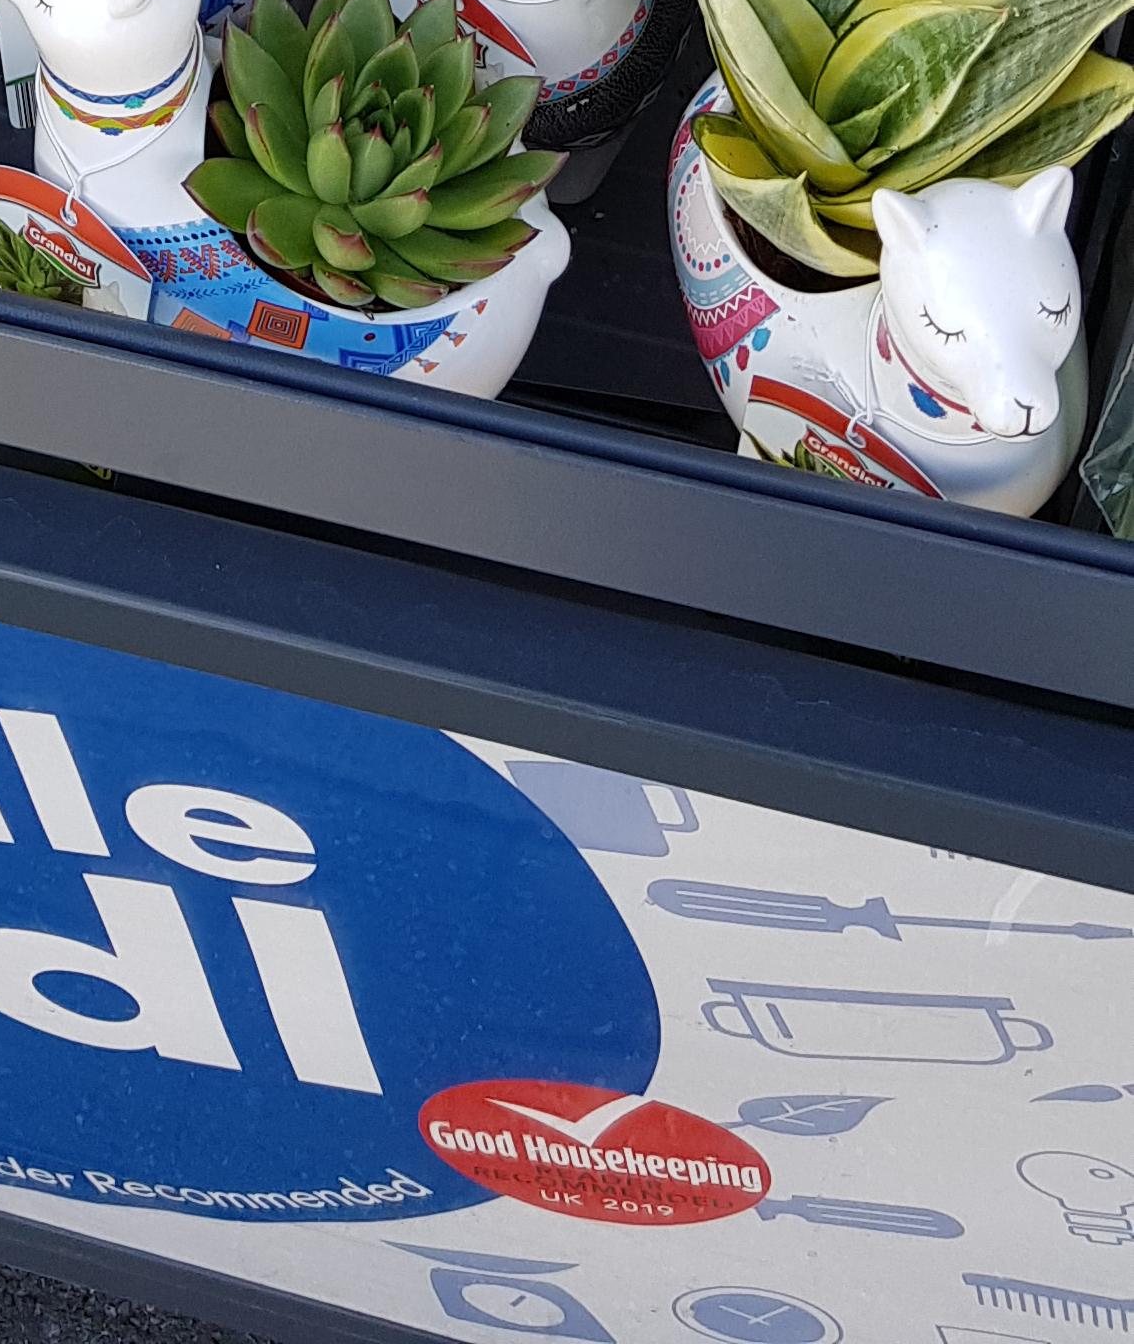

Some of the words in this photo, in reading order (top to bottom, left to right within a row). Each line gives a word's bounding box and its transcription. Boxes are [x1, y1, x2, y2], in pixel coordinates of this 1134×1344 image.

[28, 228, 92, 276] Grandiol
[428, 1120, 518, 1160] Good
[523, 1133, 763, 1192] Housekeeping
[83, 1167, 434, 1210] Recommended
[539, 1189, 584, 1206] UK
[602, 1198, 674, 1216] 2019
